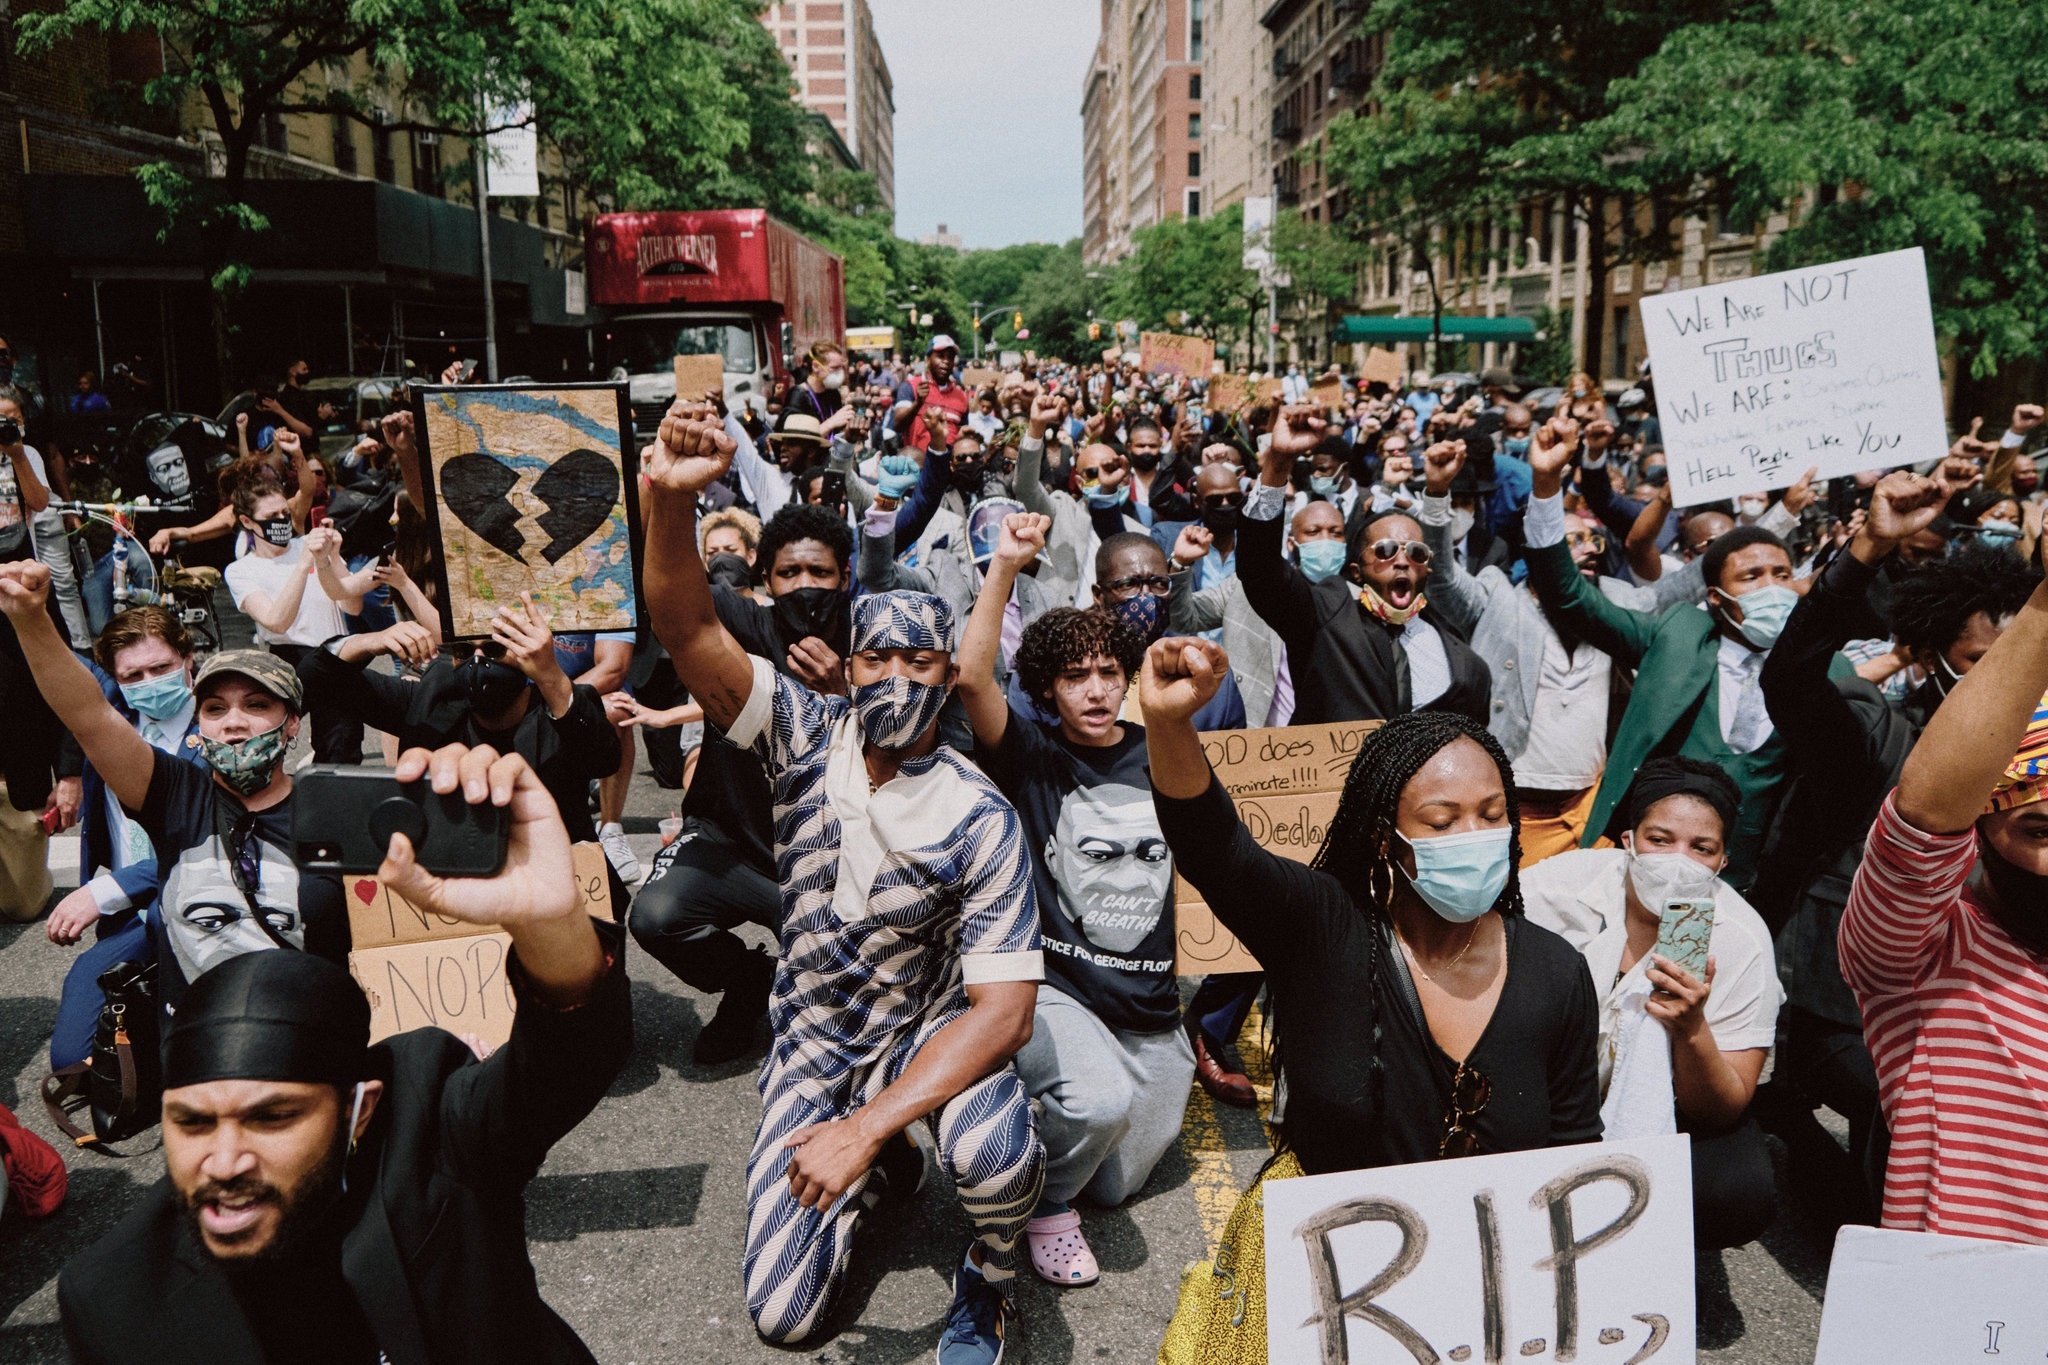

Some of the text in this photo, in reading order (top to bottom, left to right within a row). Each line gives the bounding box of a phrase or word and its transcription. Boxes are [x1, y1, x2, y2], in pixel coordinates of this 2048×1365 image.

[637, 235, 718, 278] ARTHUR WERNER
[1784, 269, 1857, 310] NOT
[1703, 331, 1837, 382] THUGS
[1686, 459, 1736, 487] HELL
[1856, 421, 1901, 455] YOU
[1203, 735, 1247, 768] OD
[1260, 735, 1314, 762] does
[1239, 801, 1333, 848] Decla
[1085, 910, 1160, 933] BREATHE
[1086, 892, 1160, 912] I CAN'T
[1040, 934, 1072, 956] STICE
[1094, 954, 1141, 971] GEORGE
[1142, 959, 1173, 972] FLOY
